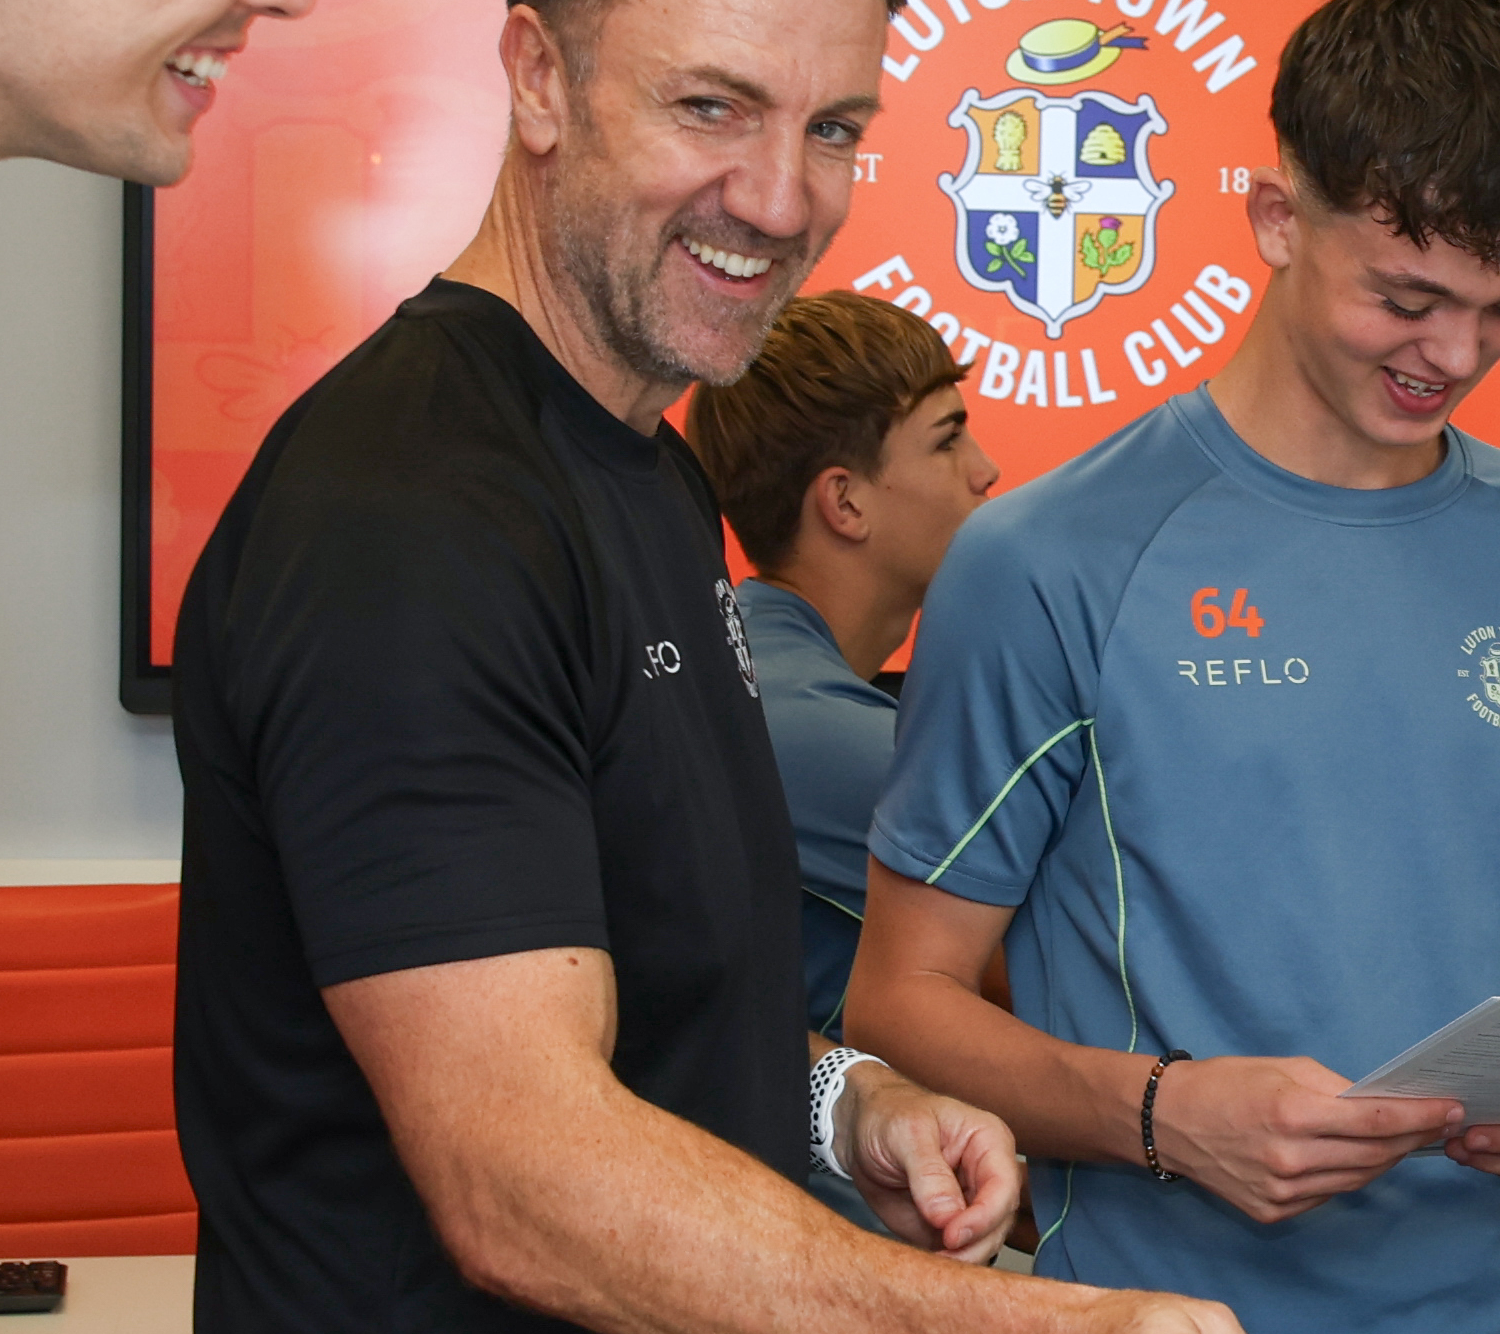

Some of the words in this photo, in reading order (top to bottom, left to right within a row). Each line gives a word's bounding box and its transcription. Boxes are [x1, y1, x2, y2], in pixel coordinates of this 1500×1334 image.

[850, 154, 882, 184] ST
[1218, 167, 1250, 195] 18
[1122, 264, 1252, 386] CLUB
[1190, 586, 1265, 639] 64
[1460, 625, 1497, 656] LUTON
[1177, 657, 1310, 686] REFLO
[1457, 669, 1470, 678] EST
